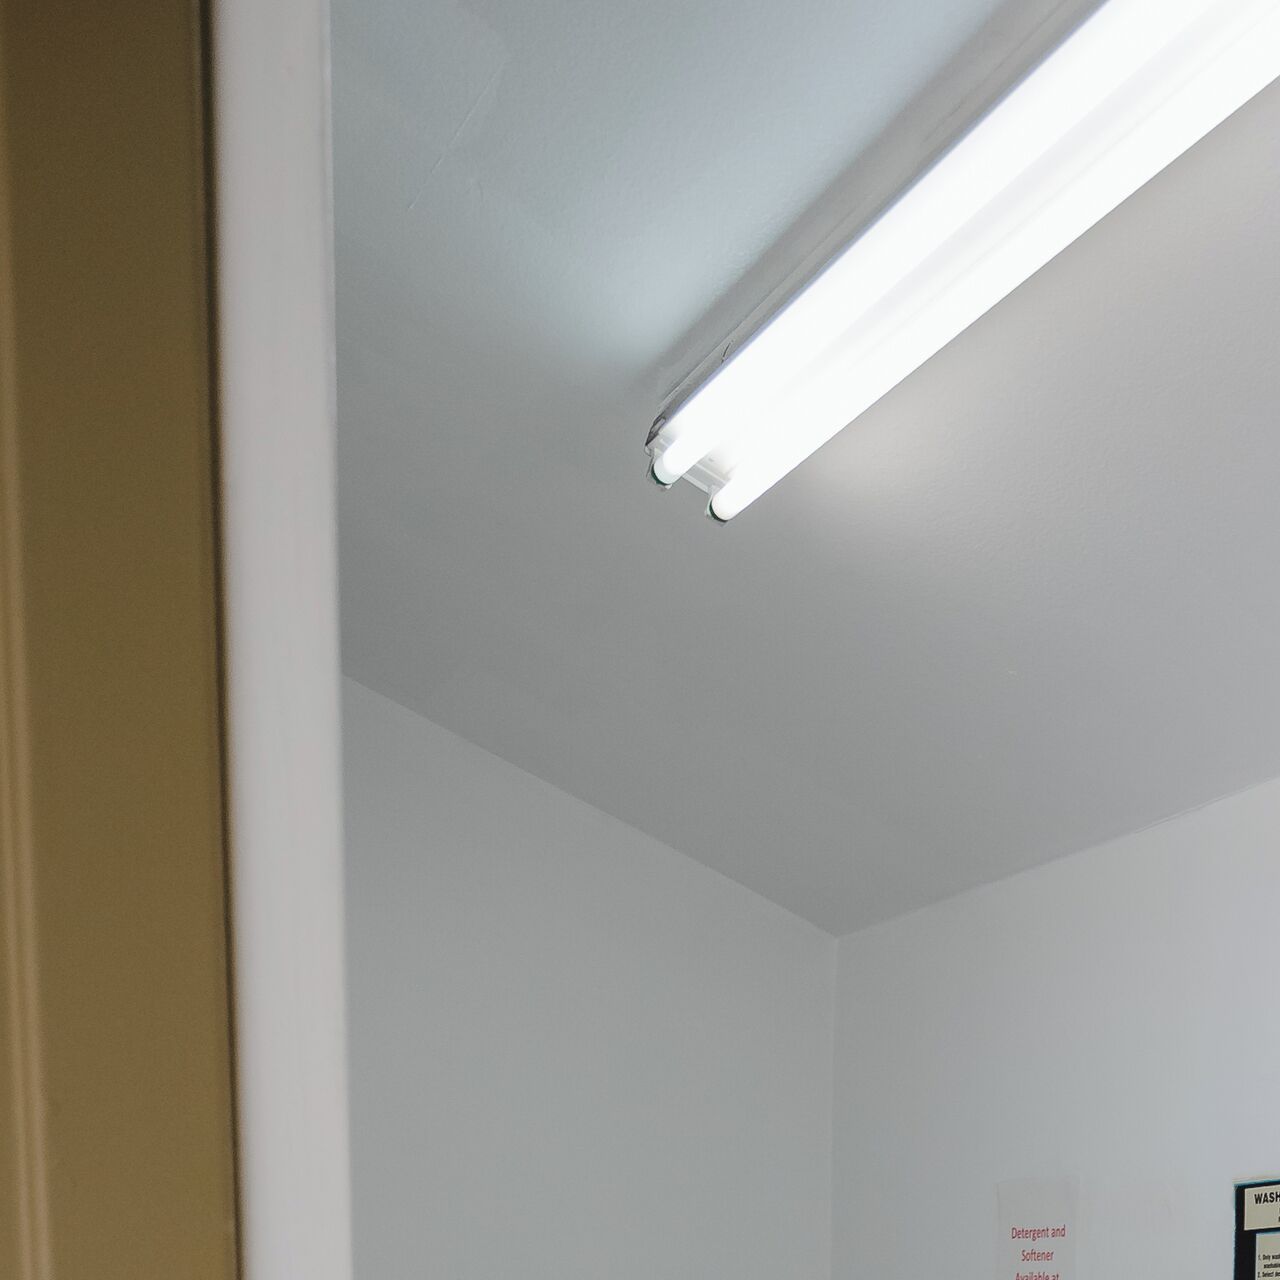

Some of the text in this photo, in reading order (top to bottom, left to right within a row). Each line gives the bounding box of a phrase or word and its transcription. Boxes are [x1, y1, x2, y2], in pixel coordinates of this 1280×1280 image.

[1011, 1224, 1066, 1241] Detergent and
[1021, 1249, 1054, 1262] Softener
